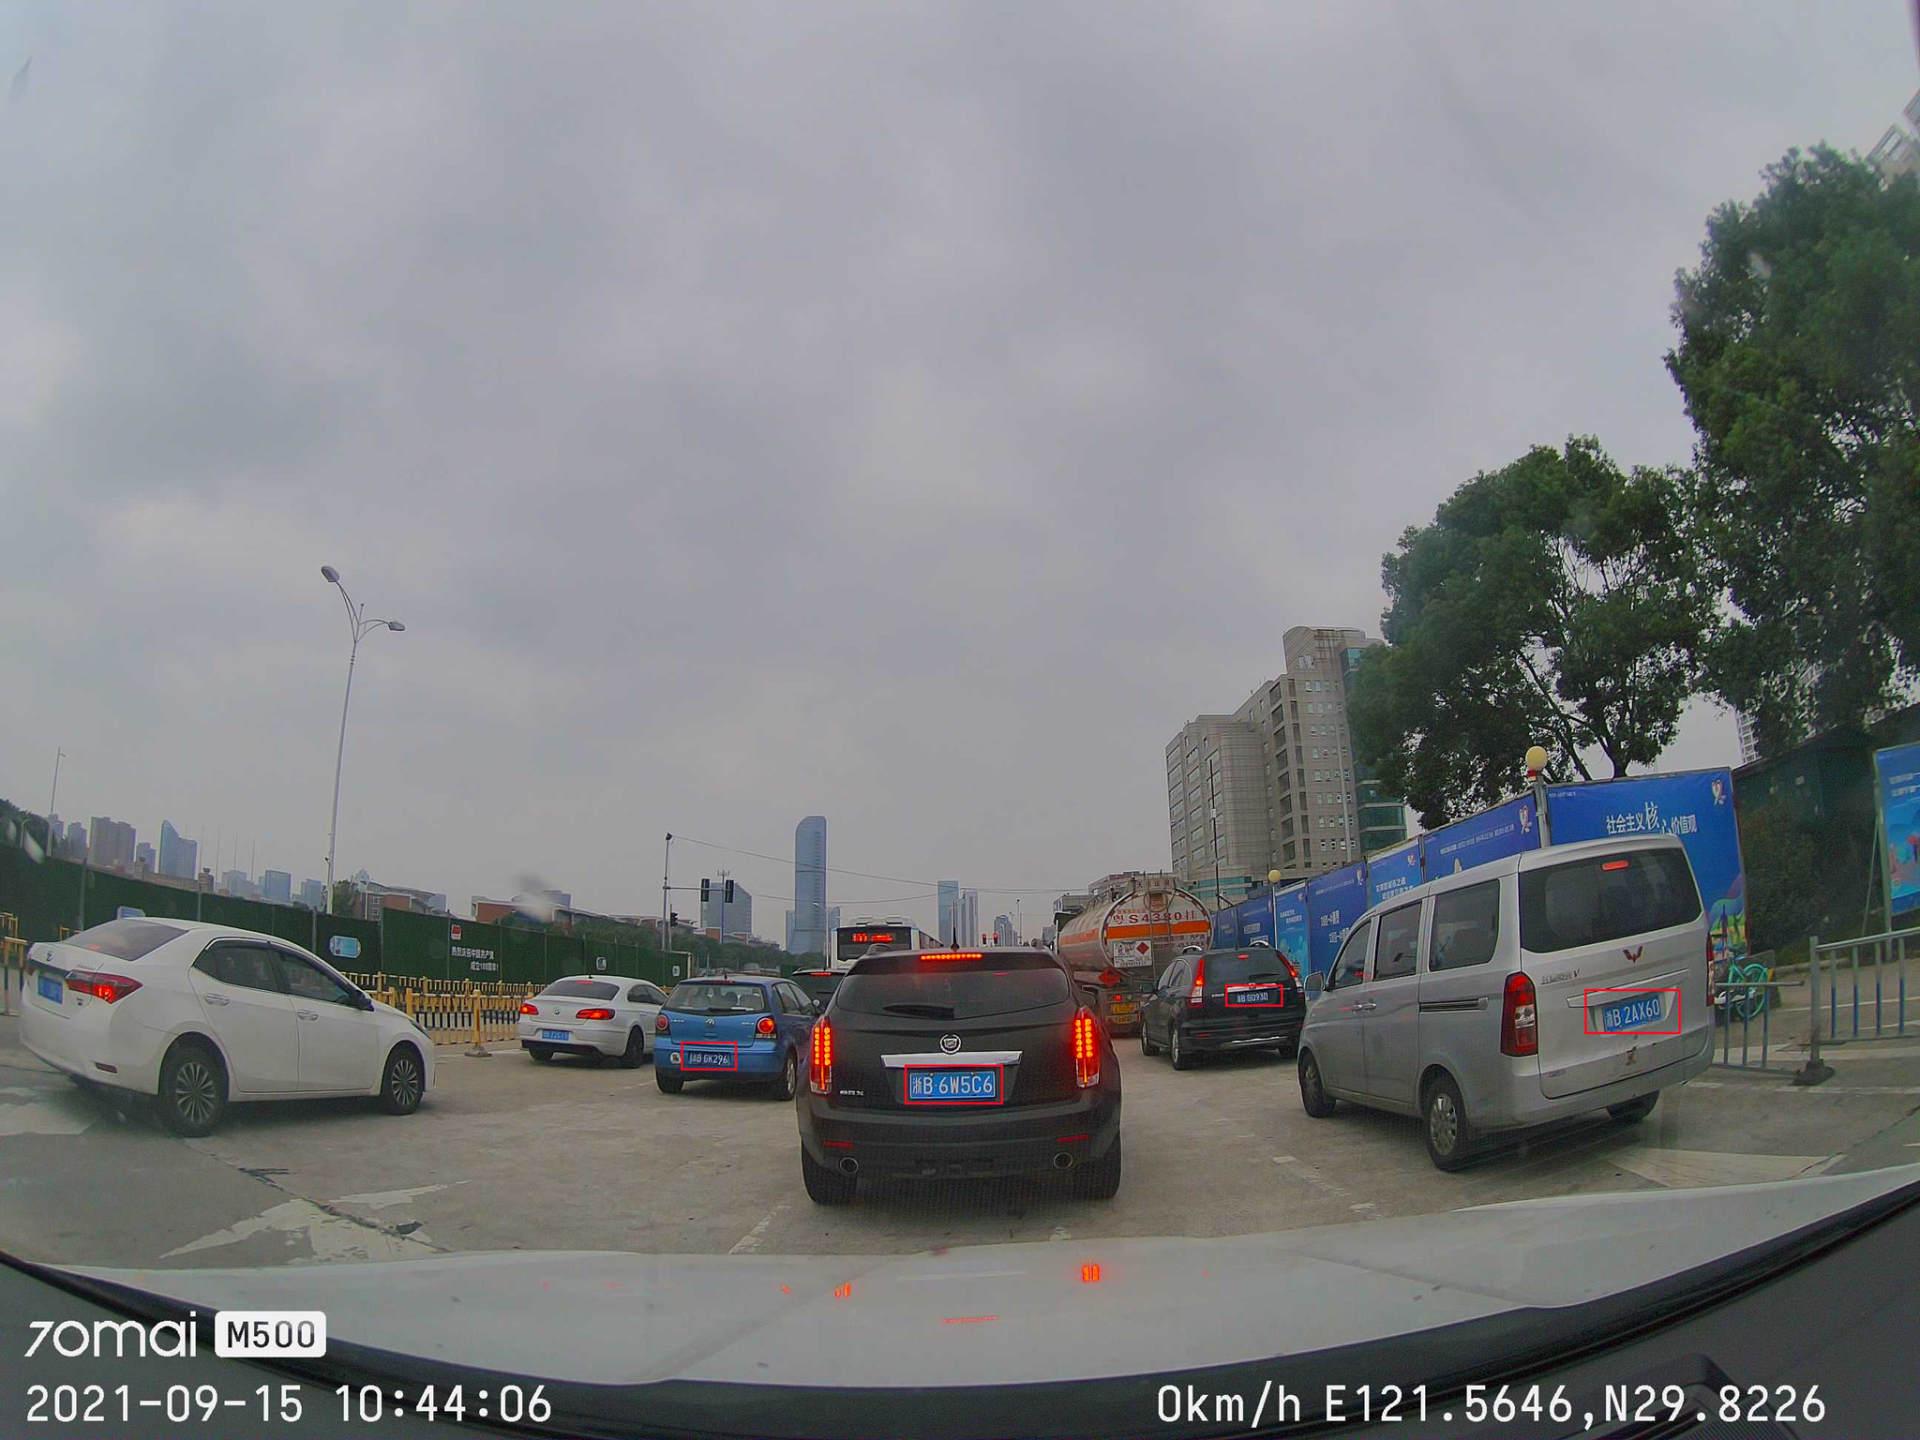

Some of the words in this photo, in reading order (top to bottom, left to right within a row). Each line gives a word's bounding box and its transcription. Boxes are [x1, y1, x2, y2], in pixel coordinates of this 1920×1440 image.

[1606, 802, 1697, 834] 社会主义核心价值观
